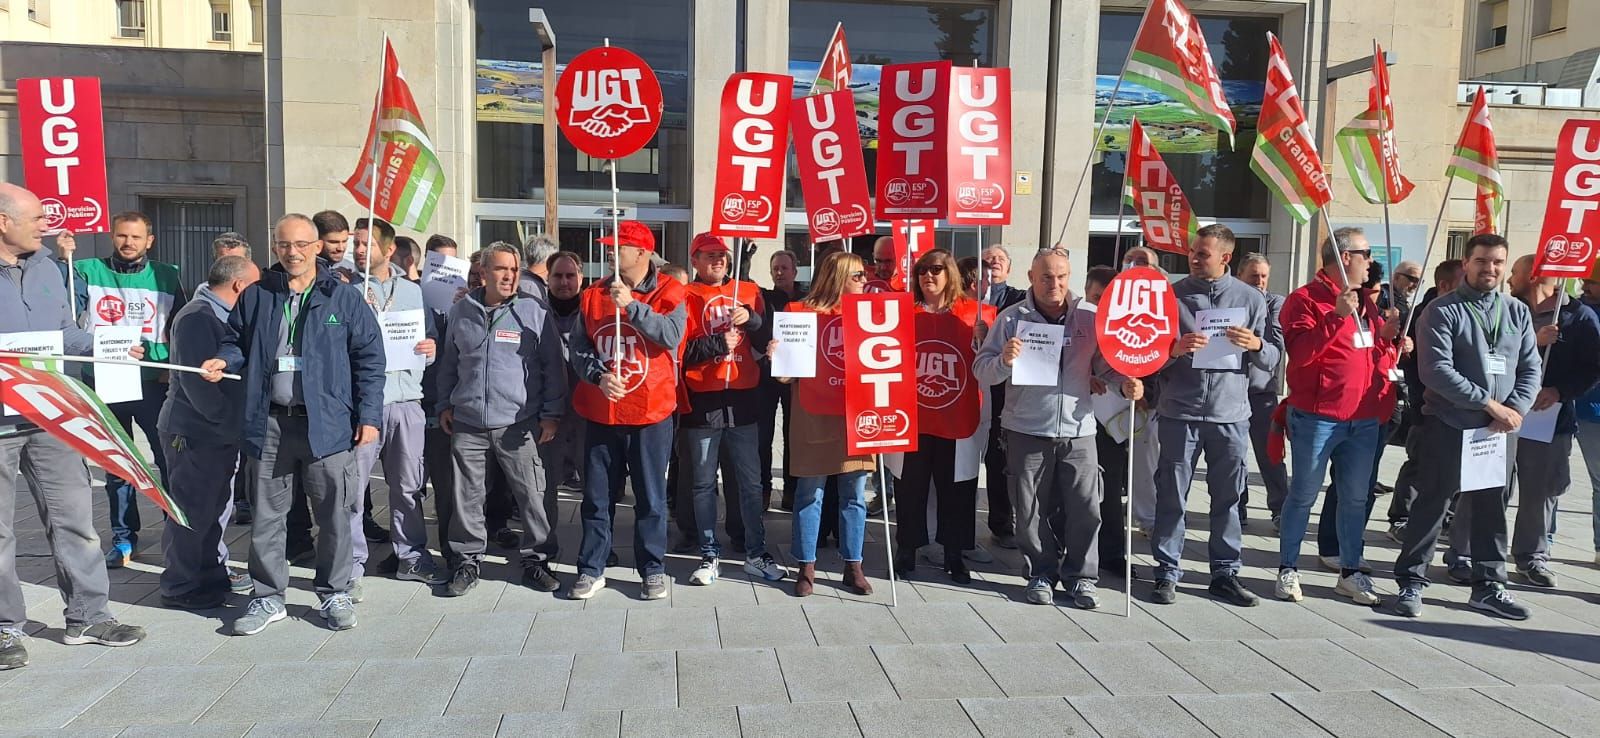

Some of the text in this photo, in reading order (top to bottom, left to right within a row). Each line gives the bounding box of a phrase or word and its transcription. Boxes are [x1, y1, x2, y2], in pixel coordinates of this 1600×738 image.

[572, 68, 642, 110] UGT
[40, 79, 80, 196] UGT
[732, 78, 778, 192] UGT
[892, 68, 937, 176] UGT
[958, 74, 999, 180] UGT
[805, 94, 846, 205] UGT
[1279, 126, 1328, 192] Granada
[724, 198, 762, 210] UGT FSP
[888, 182, 906, 193] UGT
[1560, 126, 1600, 234] UGT
[816, 212, 836, 226] UGT
[1108, 279, 1167, 320] UGT
[597, 336, 637, 361] UGT
[856, 300, 902, 408] UGT
[1115, 350, 1160, 364] Andalucía
[858, 415, 897, 427] UGT FSP
